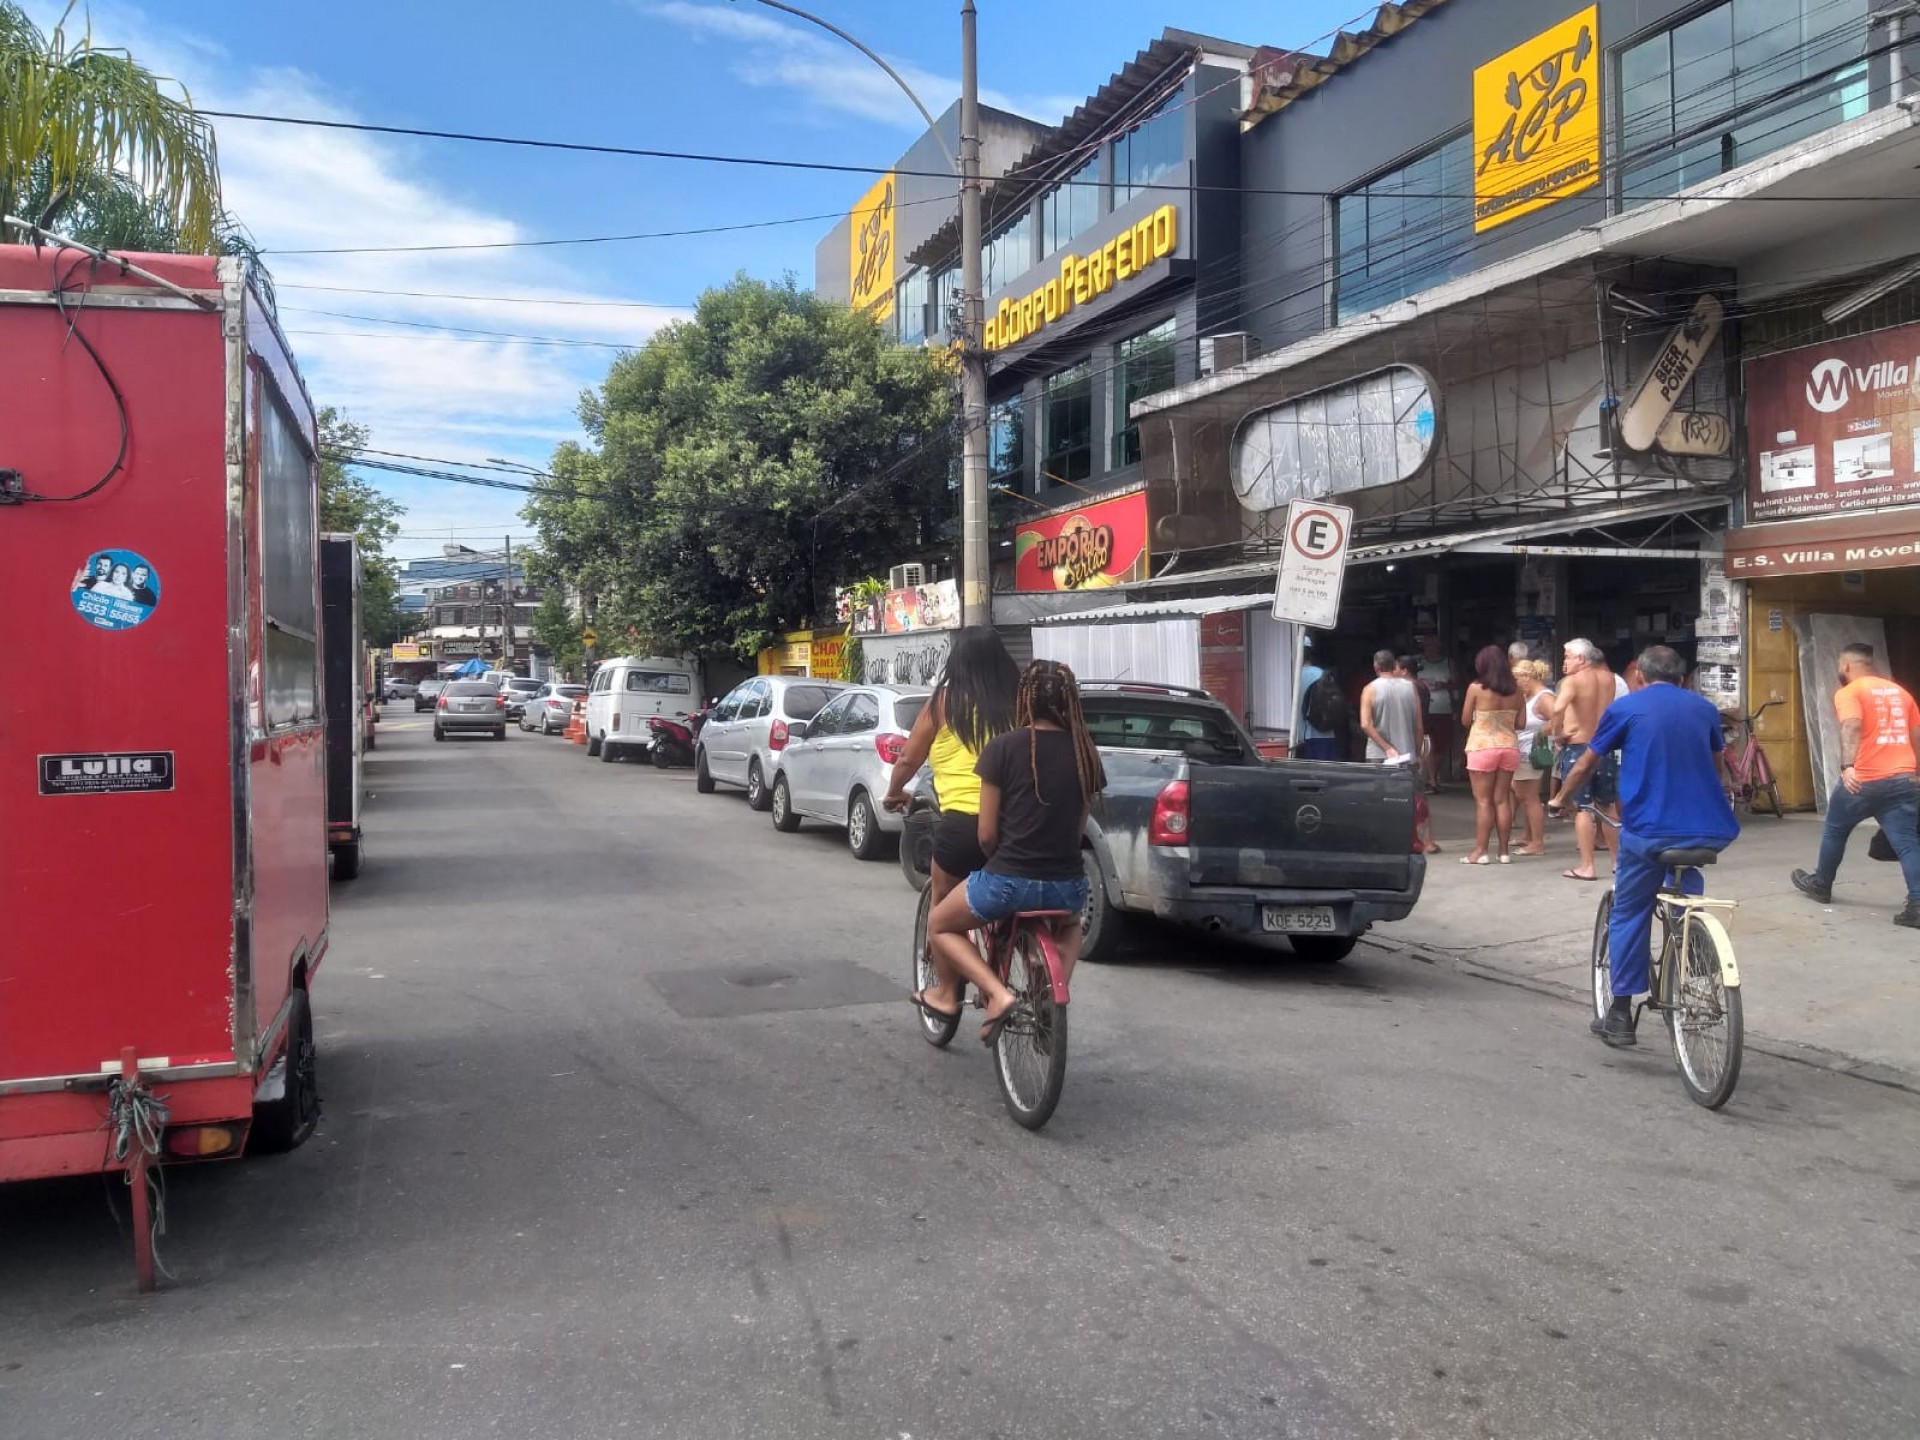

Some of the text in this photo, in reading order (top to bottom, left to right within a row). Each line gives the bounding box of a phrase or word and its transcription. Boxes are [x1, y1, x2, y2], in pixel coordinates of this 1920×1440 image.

[998, 204, 1177, 346] CORPO PERFEITO
[1655, 344, 1682, 384] BEER
[1661, 349, 1693, 402] POINT
[1855, 361, 1909, 392] Villa
[1834, 488, 1860, 499] Jardim
[1862, 484, 1893, 496] América
[1840, 498, 1865, 509] Cartão
[1307, 519, 1328, 550] E
[1783, 550, 1834, 564] Villa
[1845, 540, 1920, 561] Móvei
[77, 600, 107, 616] 5553
[1297, 913, 1331, 928] 5229
